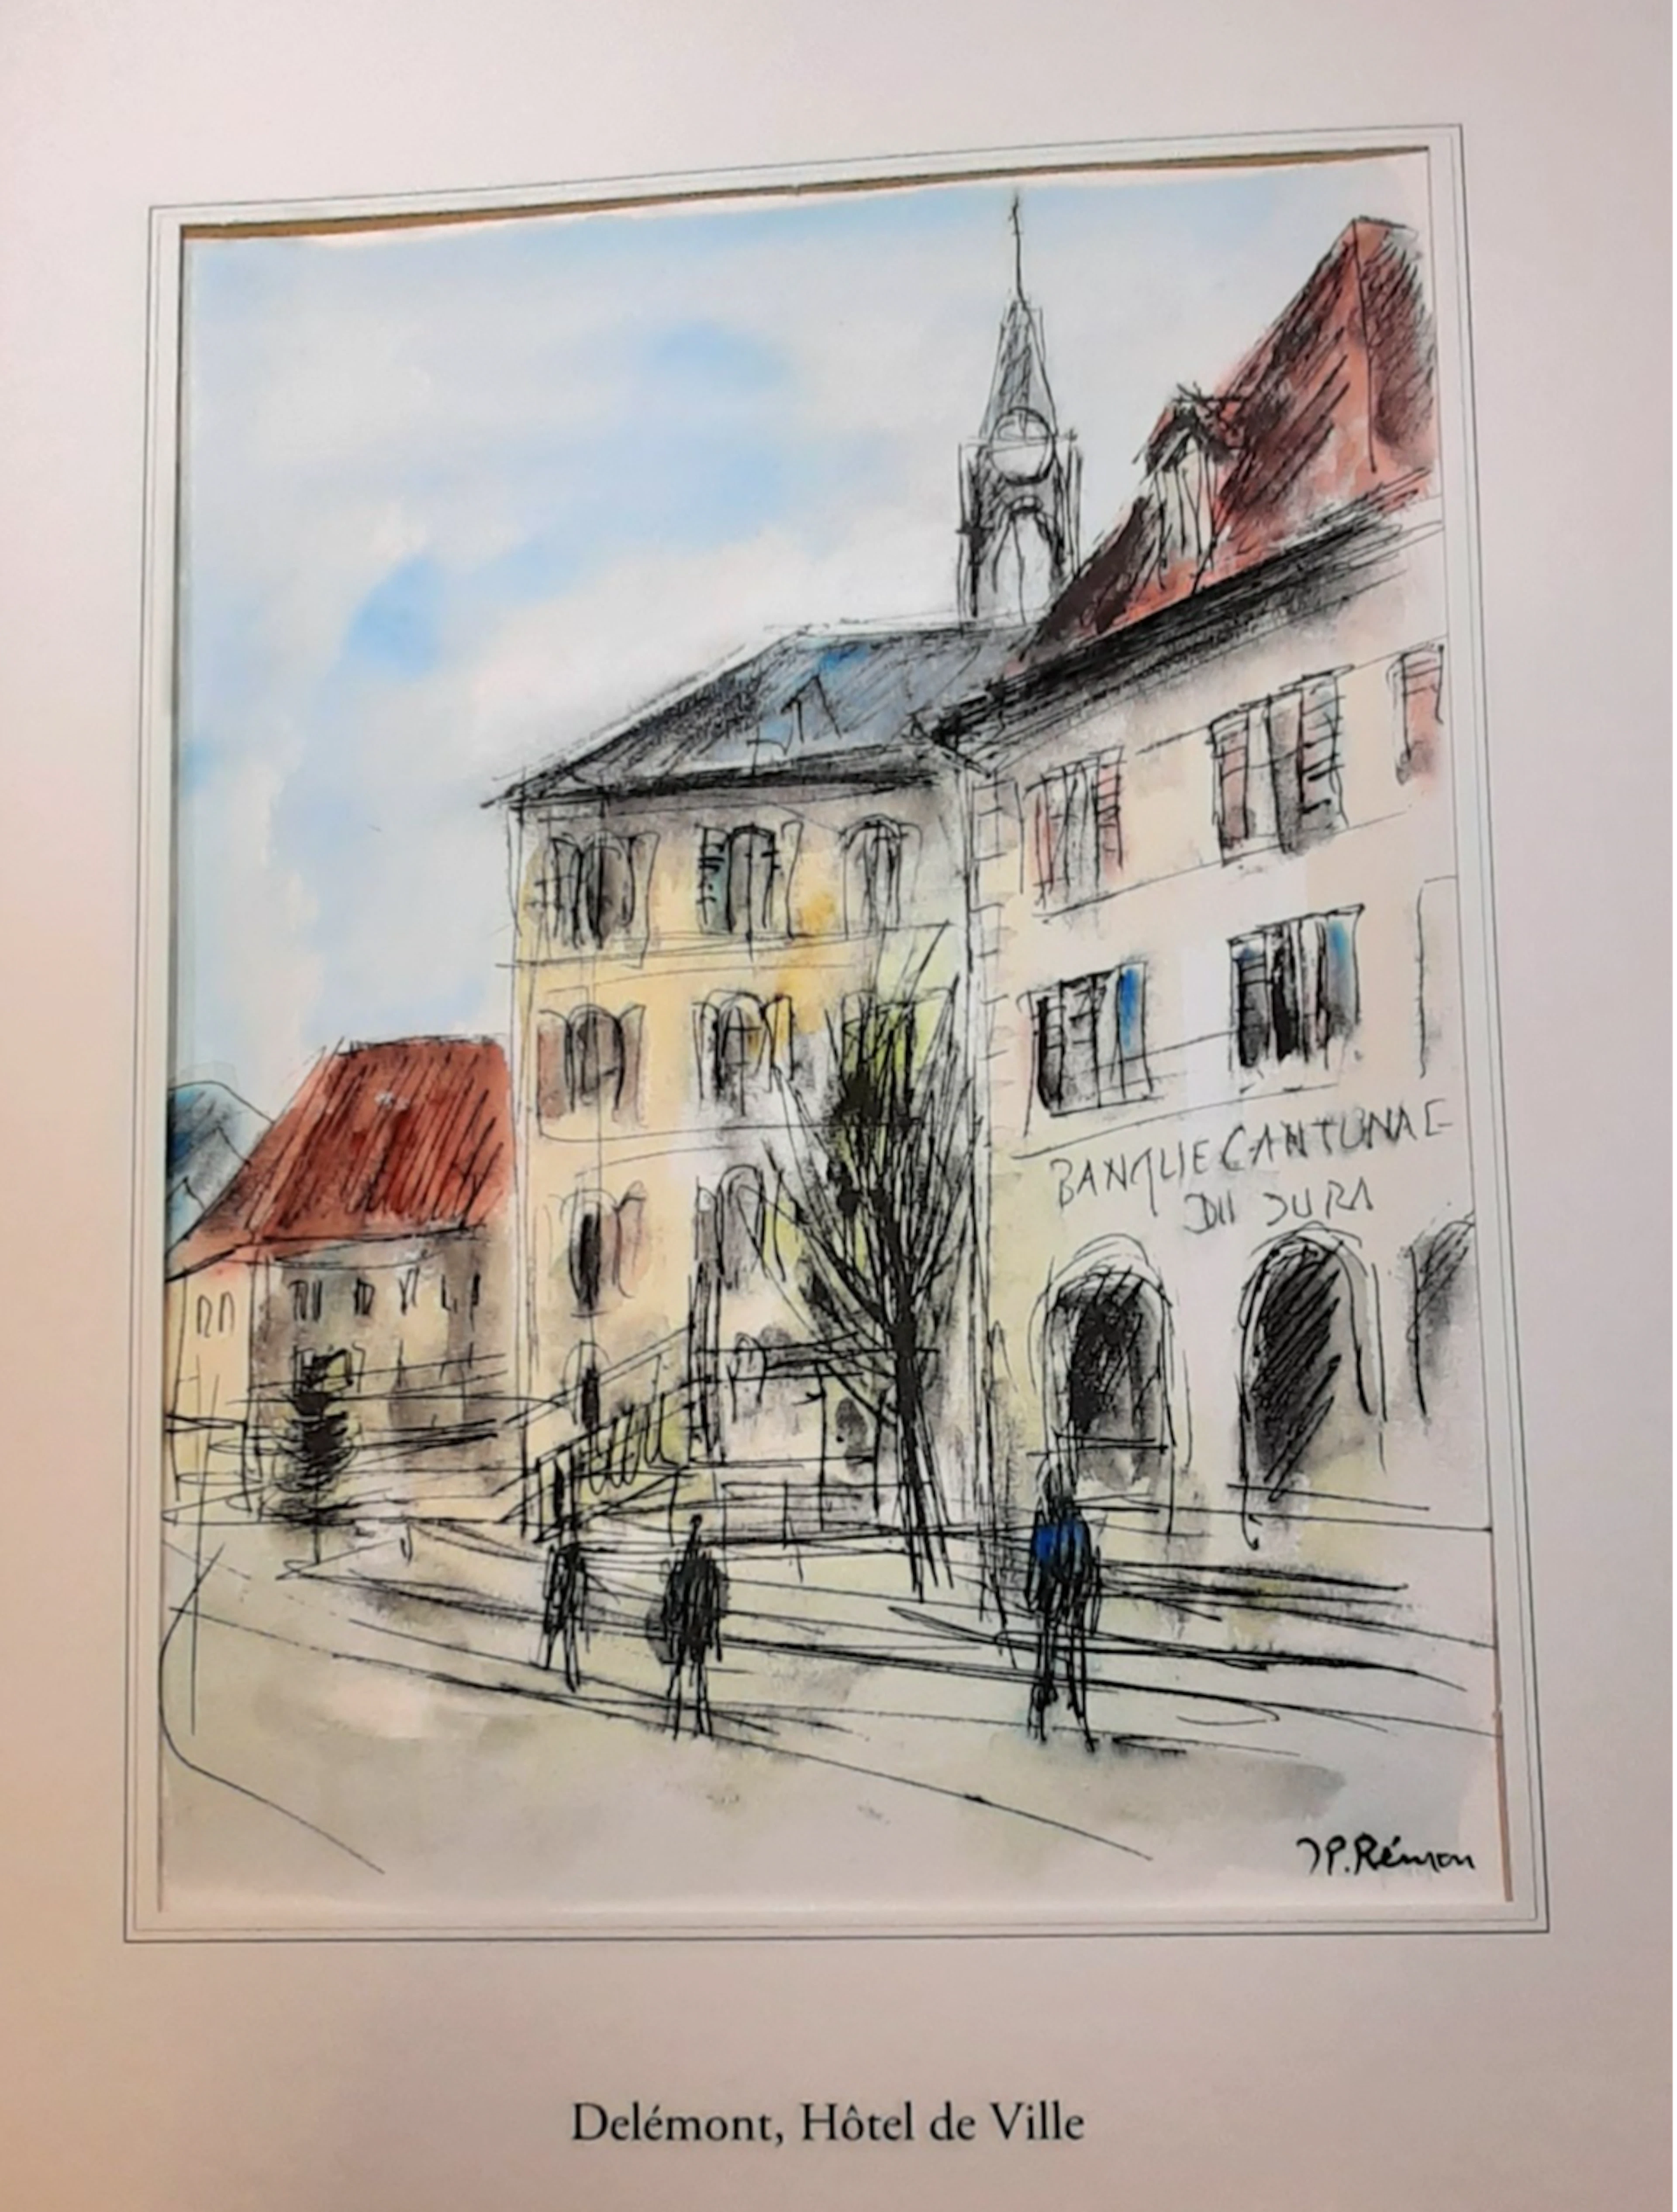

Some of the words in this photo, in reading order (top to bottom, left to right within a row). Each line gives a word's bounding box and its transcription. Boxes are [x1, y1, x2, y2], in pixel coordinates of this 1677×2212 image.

[1263, 1177, 1374, 1226] JURA
[571, 2101, 784, 2147] Delémont,
[800, 2100, 915, 2142] Hôtel
[929, 2100, 977, 2142] de
[990, 2099, 1085, 2141] Ville
